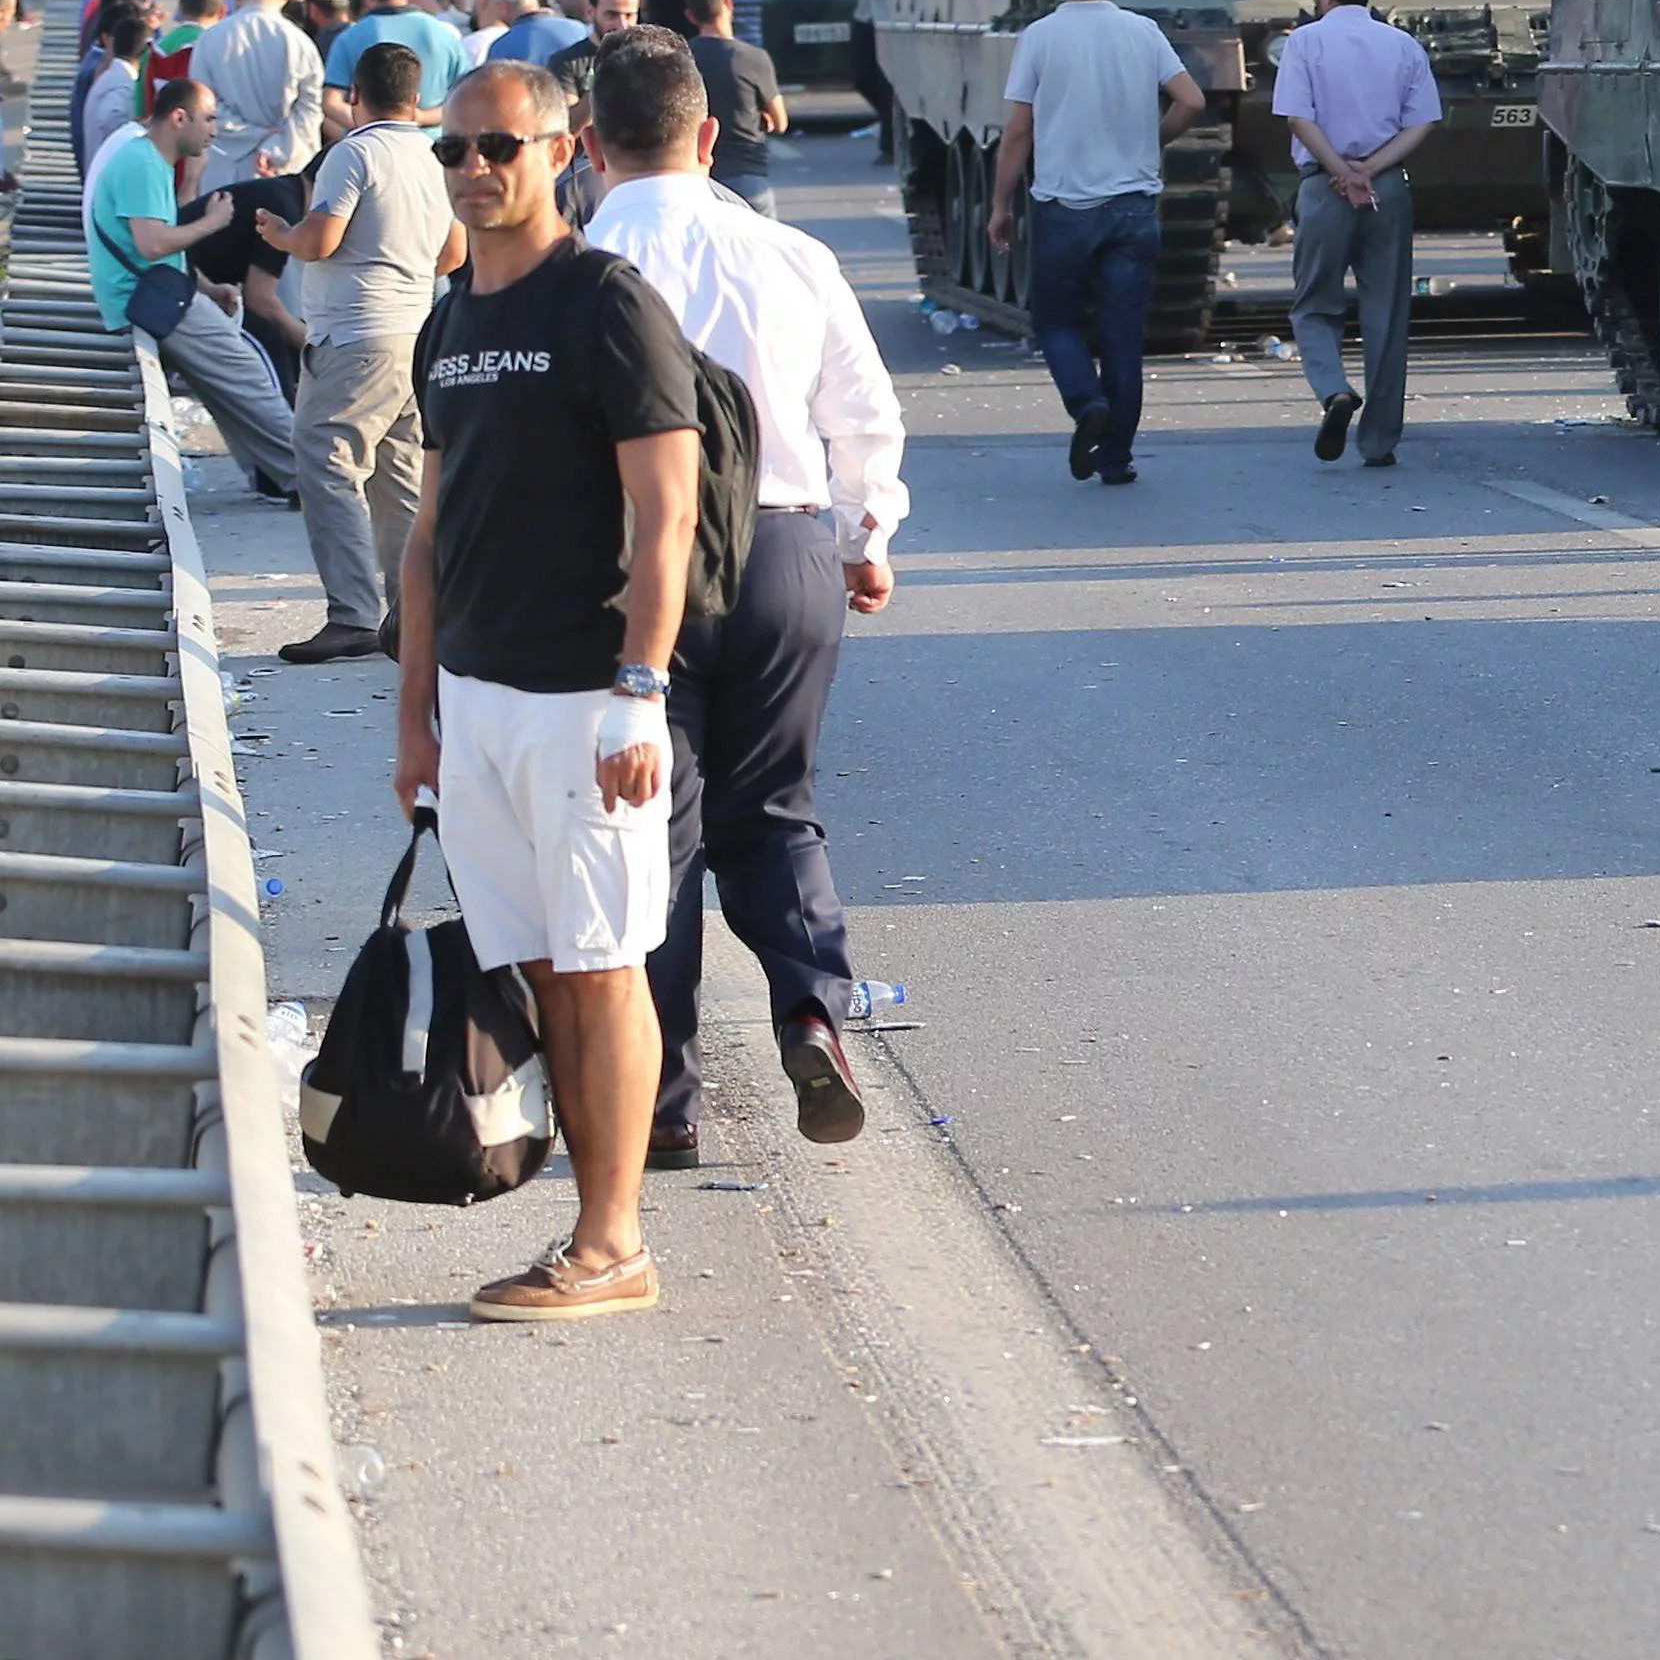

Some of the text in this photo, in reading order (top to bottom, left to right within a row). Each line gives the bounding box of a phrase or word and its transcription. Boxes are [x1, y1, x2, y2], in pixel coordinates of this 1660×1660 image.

[1493, 108, 1531, 124] 563
[471, 350, 552, 373] JEANS
[440, 371, 500, 389] LOS ANGELES
